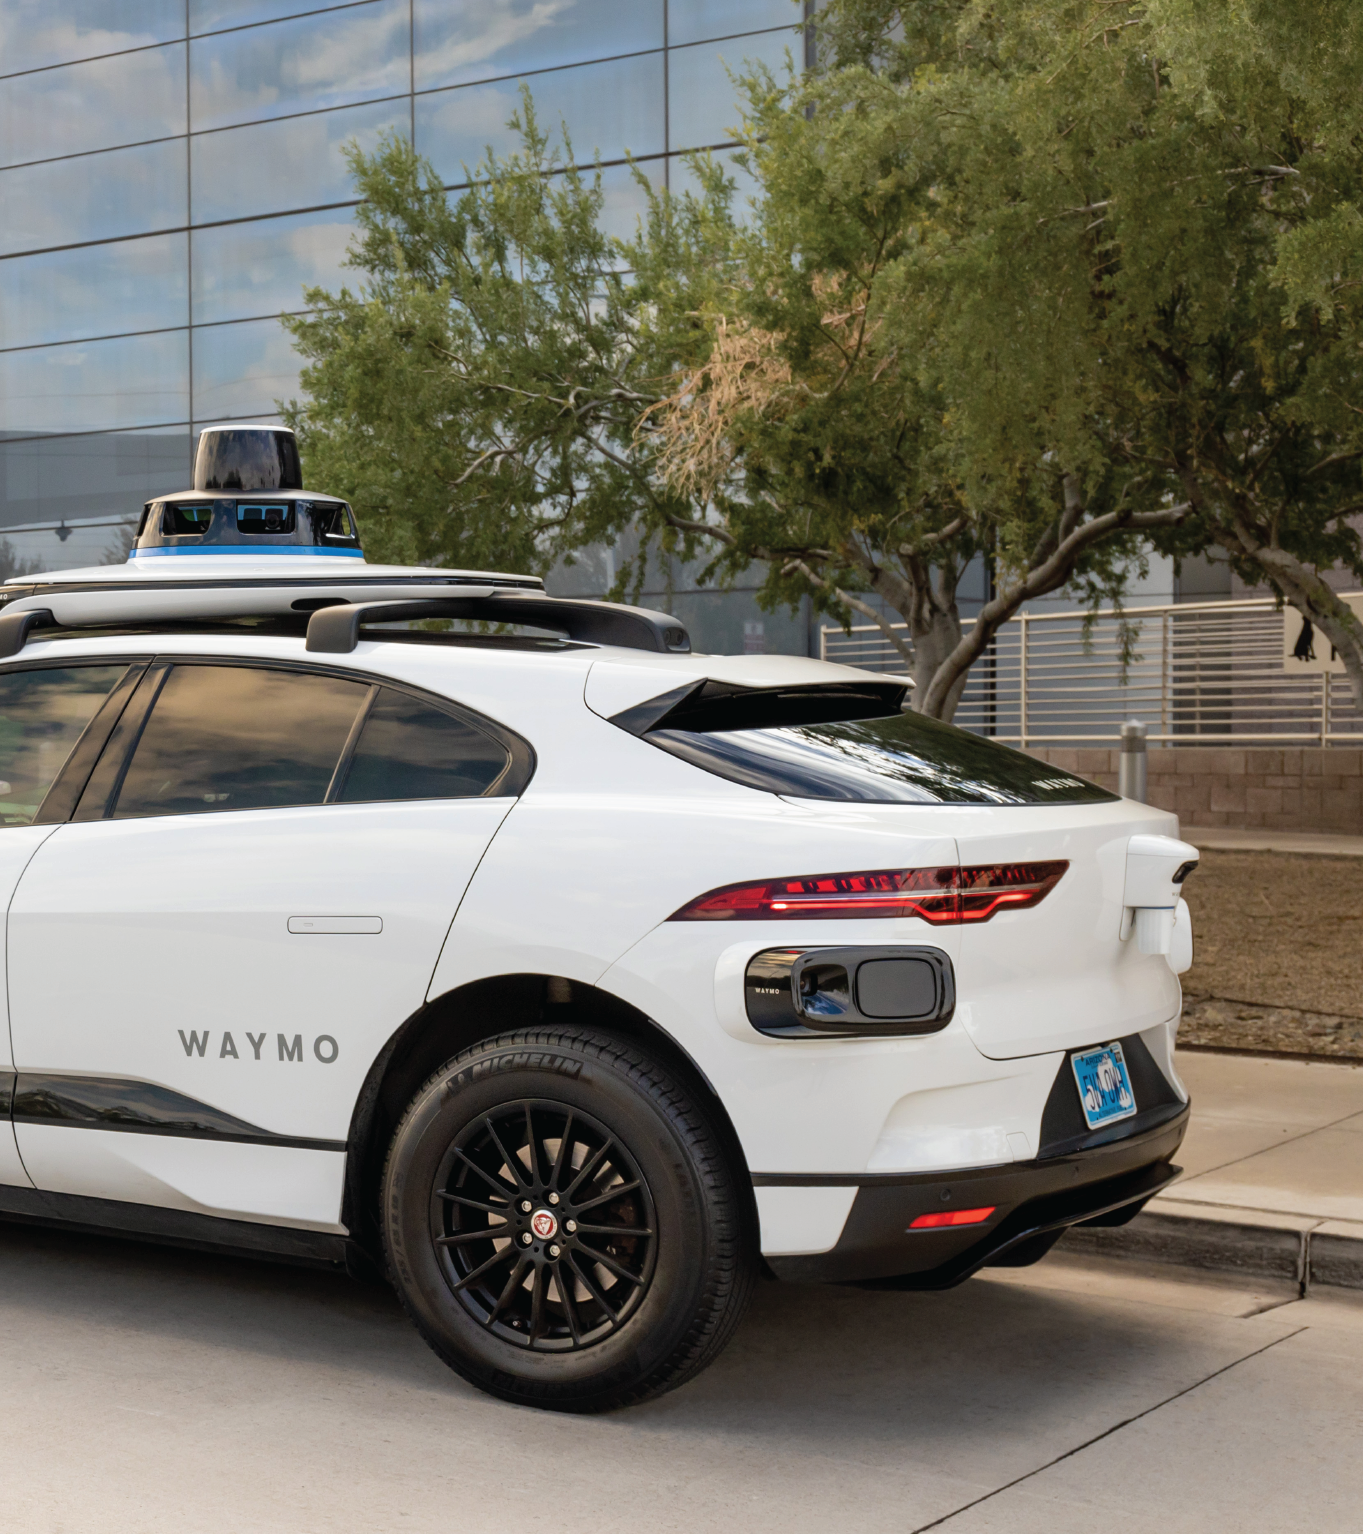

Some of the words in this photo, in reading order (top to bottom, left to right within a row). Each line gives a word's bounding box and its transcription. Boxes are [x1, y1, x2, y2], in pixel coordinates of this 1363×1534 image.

[1031, 778, 1086, 790] WAYMO
[755, 987, 780, 995] WAYMO
[177, 1029, 339, 1064] WAYMO
[472, 1053, 583, 1078] MICHELIN
[1085, 1053, 1111, 1066] ARIZONA
